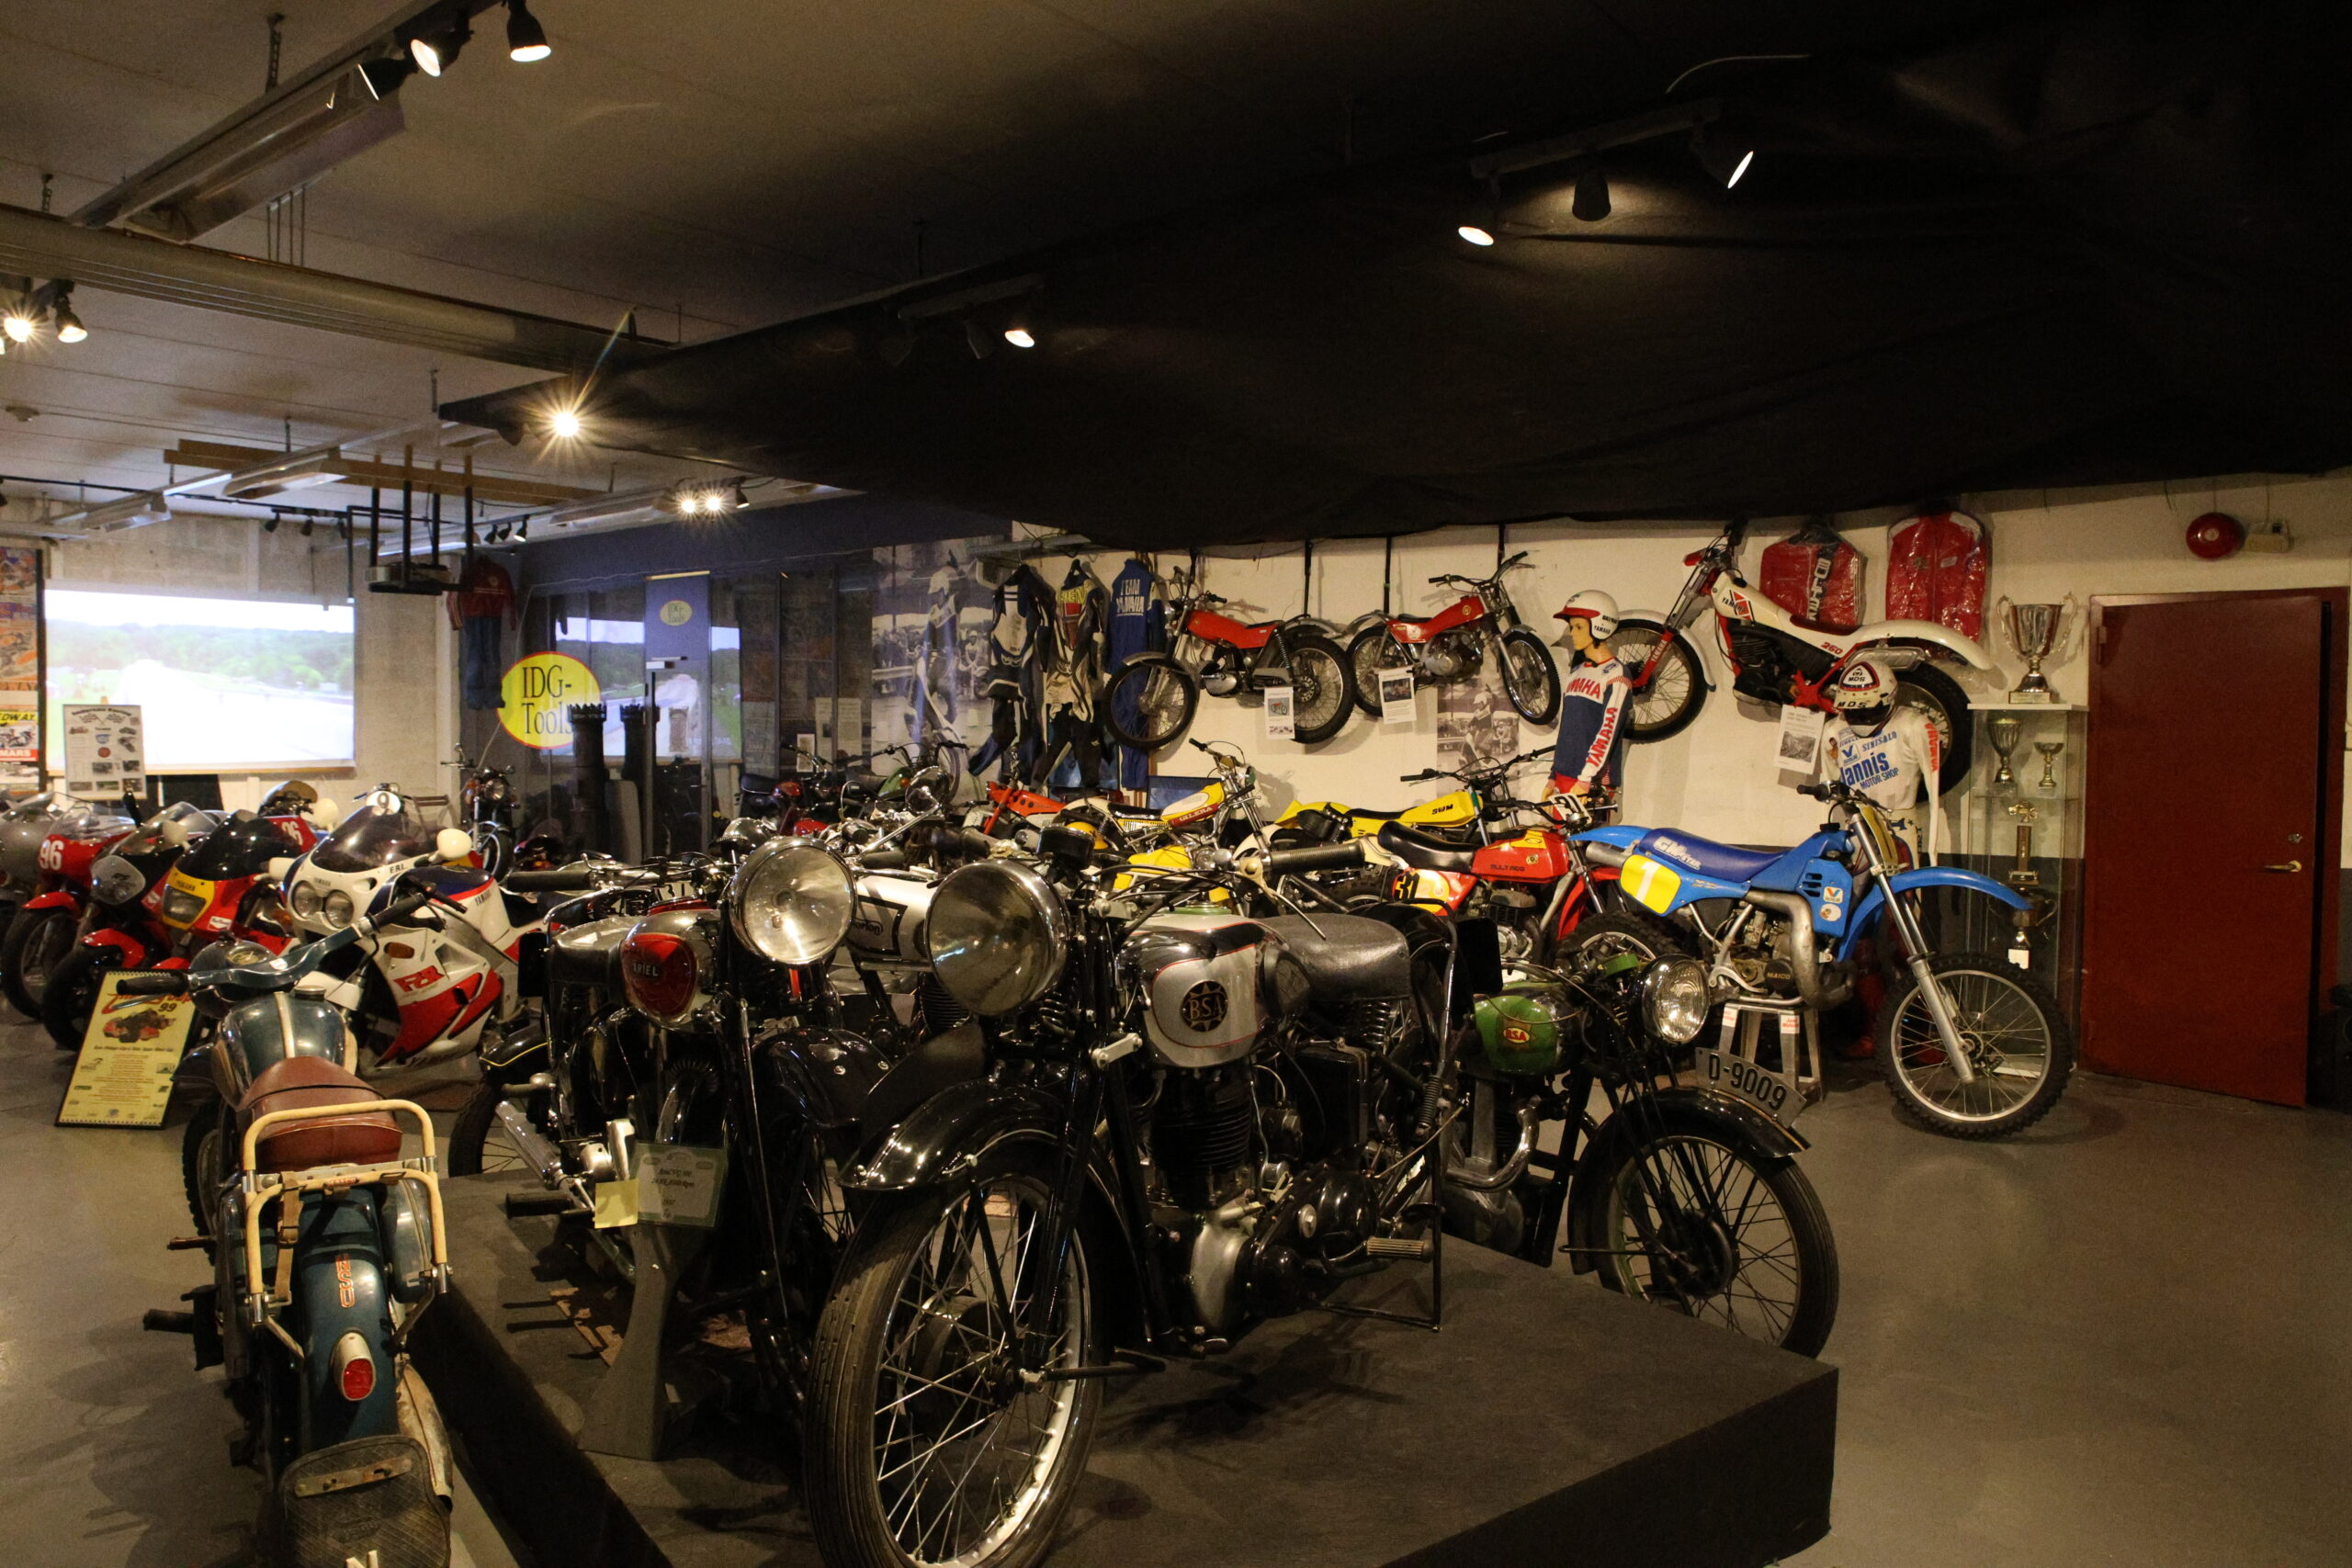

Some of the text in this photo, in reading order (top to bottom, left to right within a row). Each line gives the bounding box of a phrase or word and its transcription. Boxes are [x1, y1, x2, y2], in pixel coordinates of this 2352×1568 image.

[1121, 579, 1141, 596] TEAM
[1594, 625, 1611, 635] YAMAHA
[1651, 639, 1668, 663] YAMAHA
[522, 665, 571, 698] IDG-
[1565, 677, 1601, 701] AMAHA
[522, 702, 573, 735] Tools
[1586, 706, 1619, 768] YAMAHA
[1860, 767, 1899, 790] MOTOR SHOP
[1431, 804, 1453, 815] SWM
[40, 840, 64, 871] 96
[1395, 871, 1420, 901] 31
[1635, 862, 1661, 903] 1
[855, 920, 881, 935] orton
[1766, 971, 1791, 980] MAICO
[157, 1002, 177, 1012] 99
[1189, 994, 1224, 1021] BSA
[1505, 1029, 1527, 1042] BSA
[1709, 1053, 1787, 1111] D-9009
[335, 1252, 356, 1309] NSU
